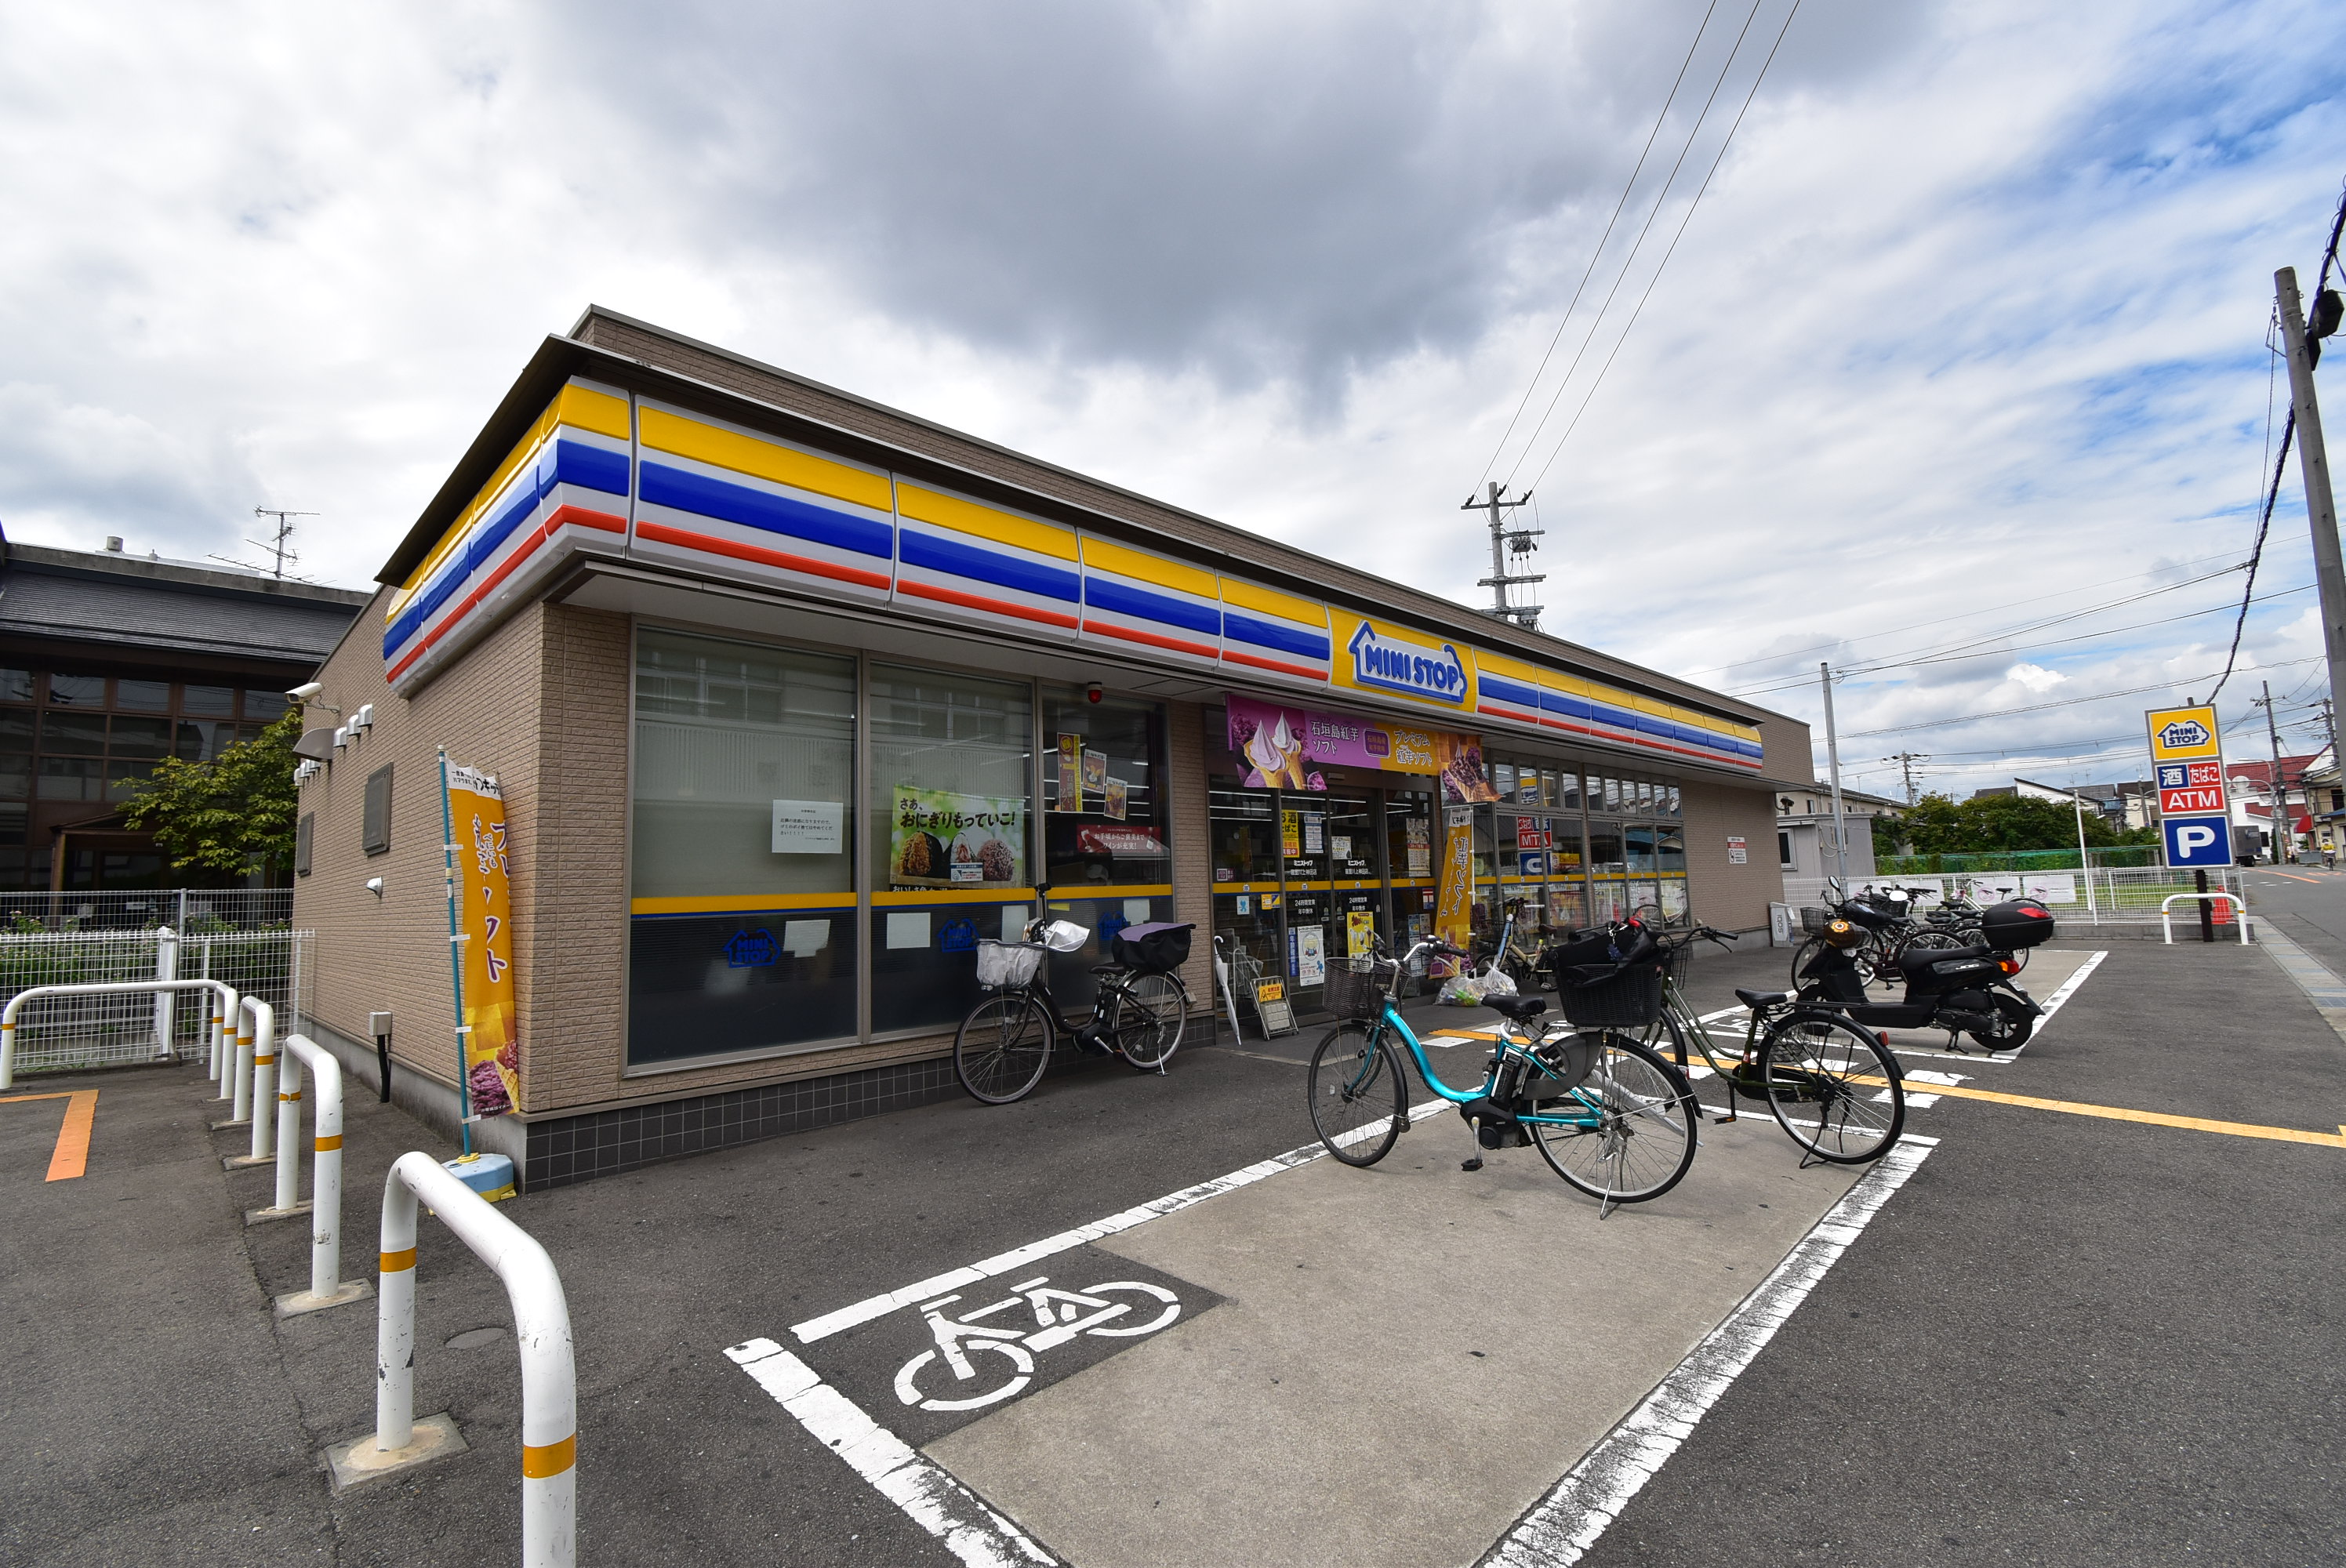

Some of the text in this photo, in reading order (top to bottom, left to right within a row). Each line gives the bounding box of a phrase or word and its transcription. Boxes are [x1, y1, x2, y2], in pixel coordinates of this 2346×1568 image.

[1364, 644, 1458, 691] MINI STOP
[1311, 720, 1359, 742] 石垣島紅芋
[1393, 729, 1431, 748] プレミアム
[2168, 735, 2199, 745] STOP
[2169, 726, 2197, 736] MINI
[1313, 739, 1338, 755] ソフト
[1396, 747, 1433, 767] 紅芋ソフト
[2162, 766, 2220, 786] 酒 たばこ
[899, 797, 923, 811] さあ、
[2168, 789, 2218, 810] ATM
[2176, 826, 2216, 858] P
[736, 938, 769, 951] MINI
[735, 950, 770, 963] STOP
